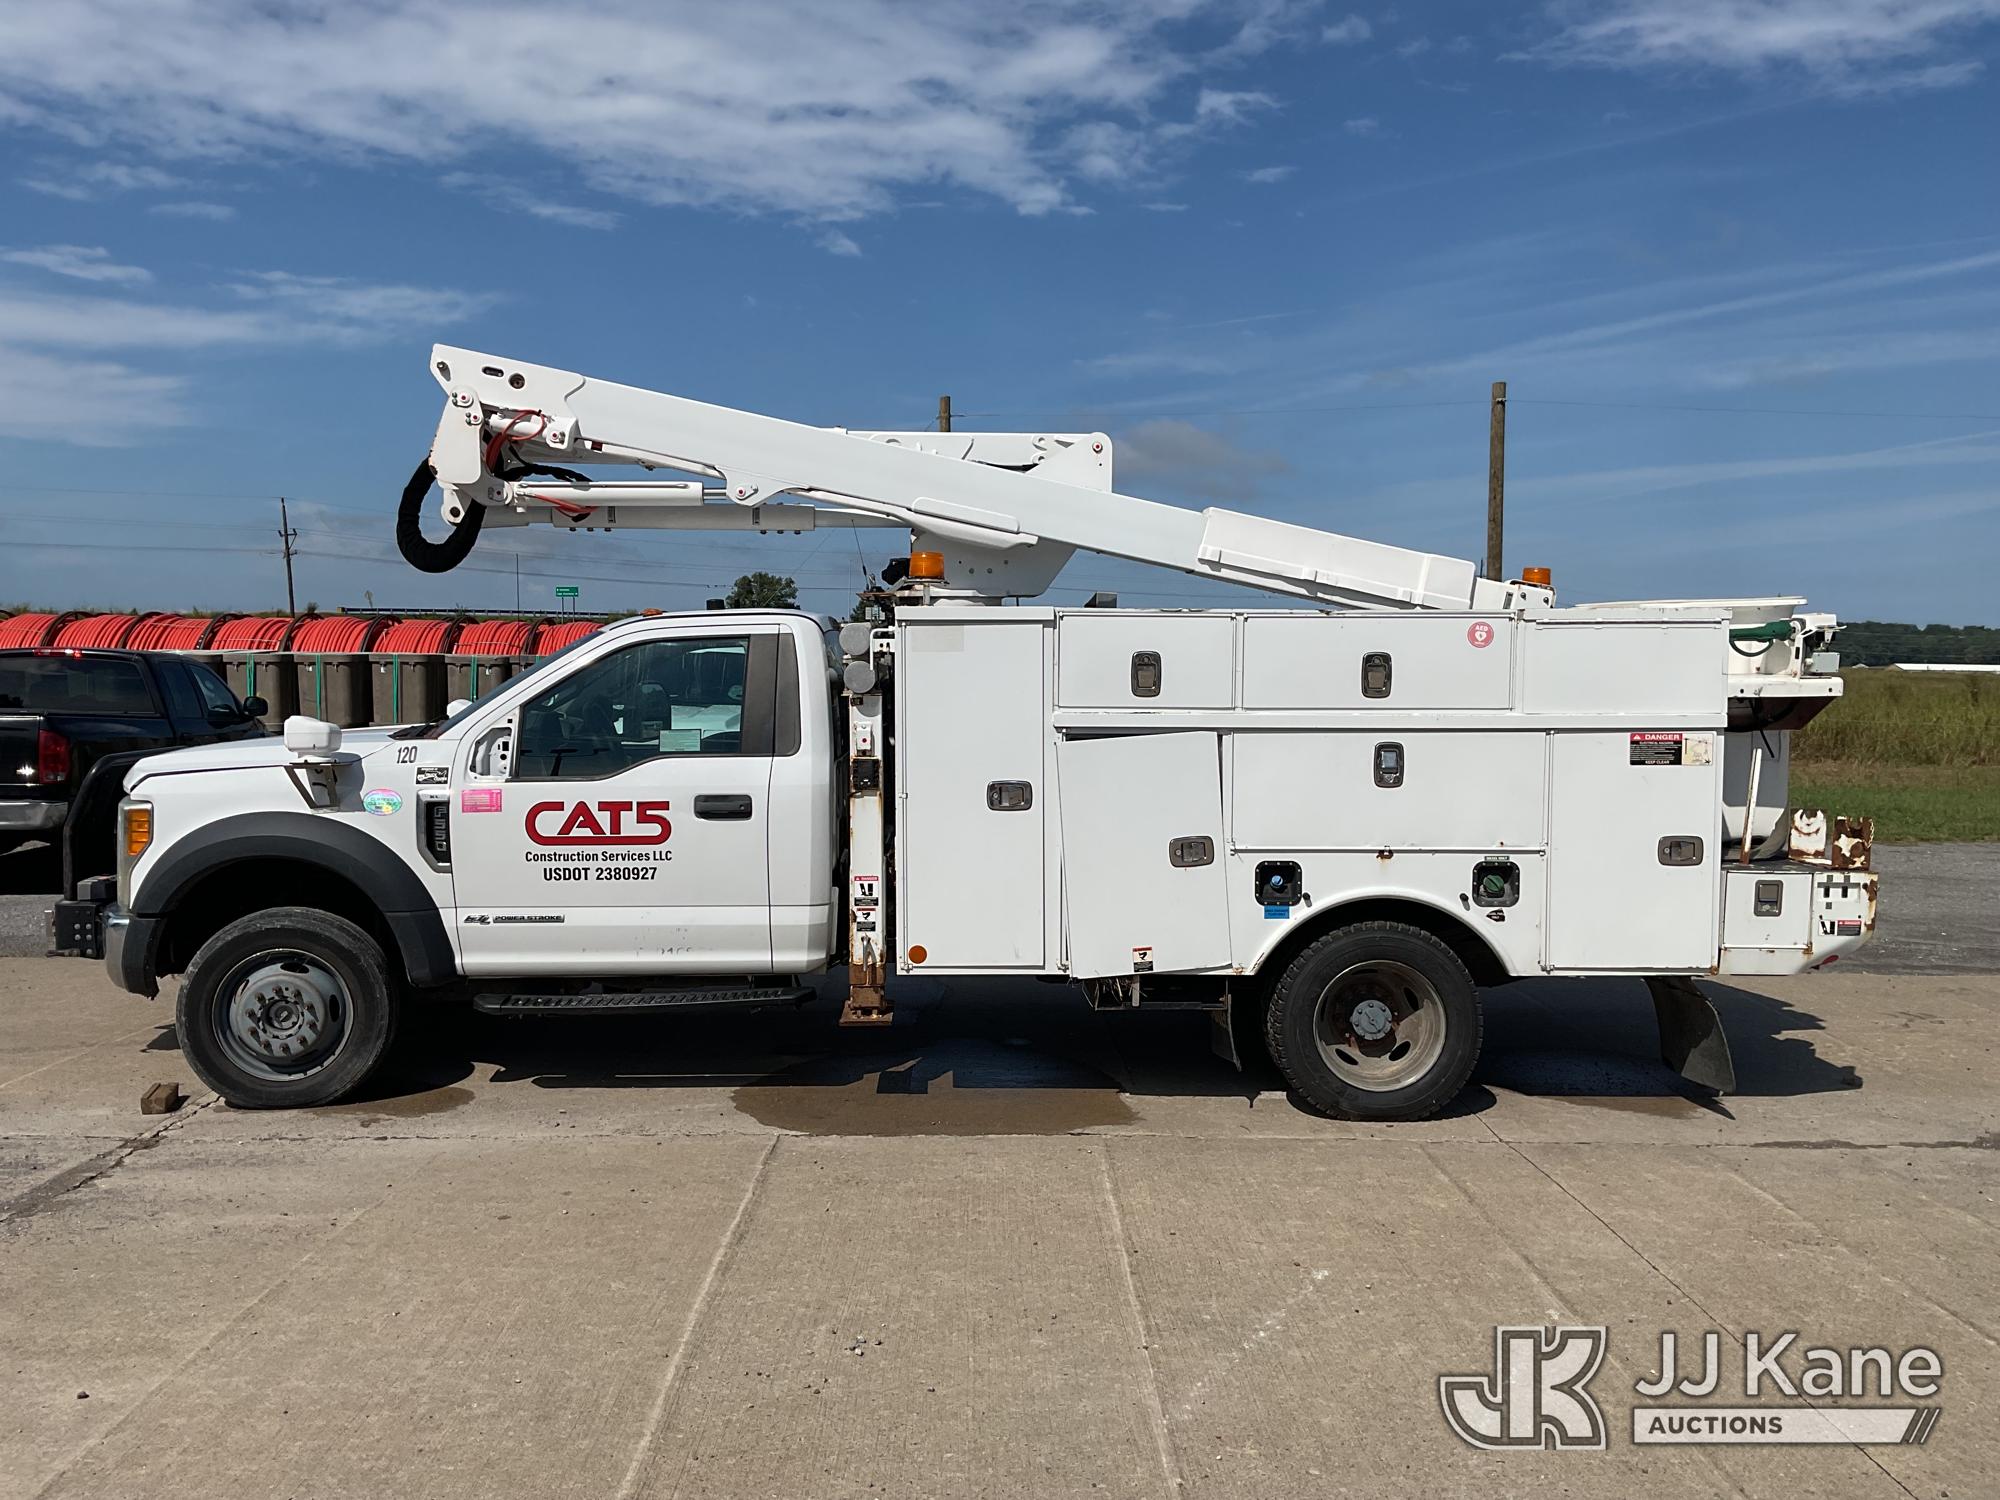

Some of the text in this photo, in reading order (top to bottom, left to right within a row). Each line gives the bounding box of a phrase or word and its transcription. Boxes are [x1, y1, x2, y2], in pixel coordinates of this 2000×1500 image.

[396, 746, 418, 764] 120
[434, 806, 447, 852] F550
[524, 800, 672, 846] CAT5
[525, 850, 673, 862] Construction Services LLC
[543, 867, 658, 881] USDOT 2380927
